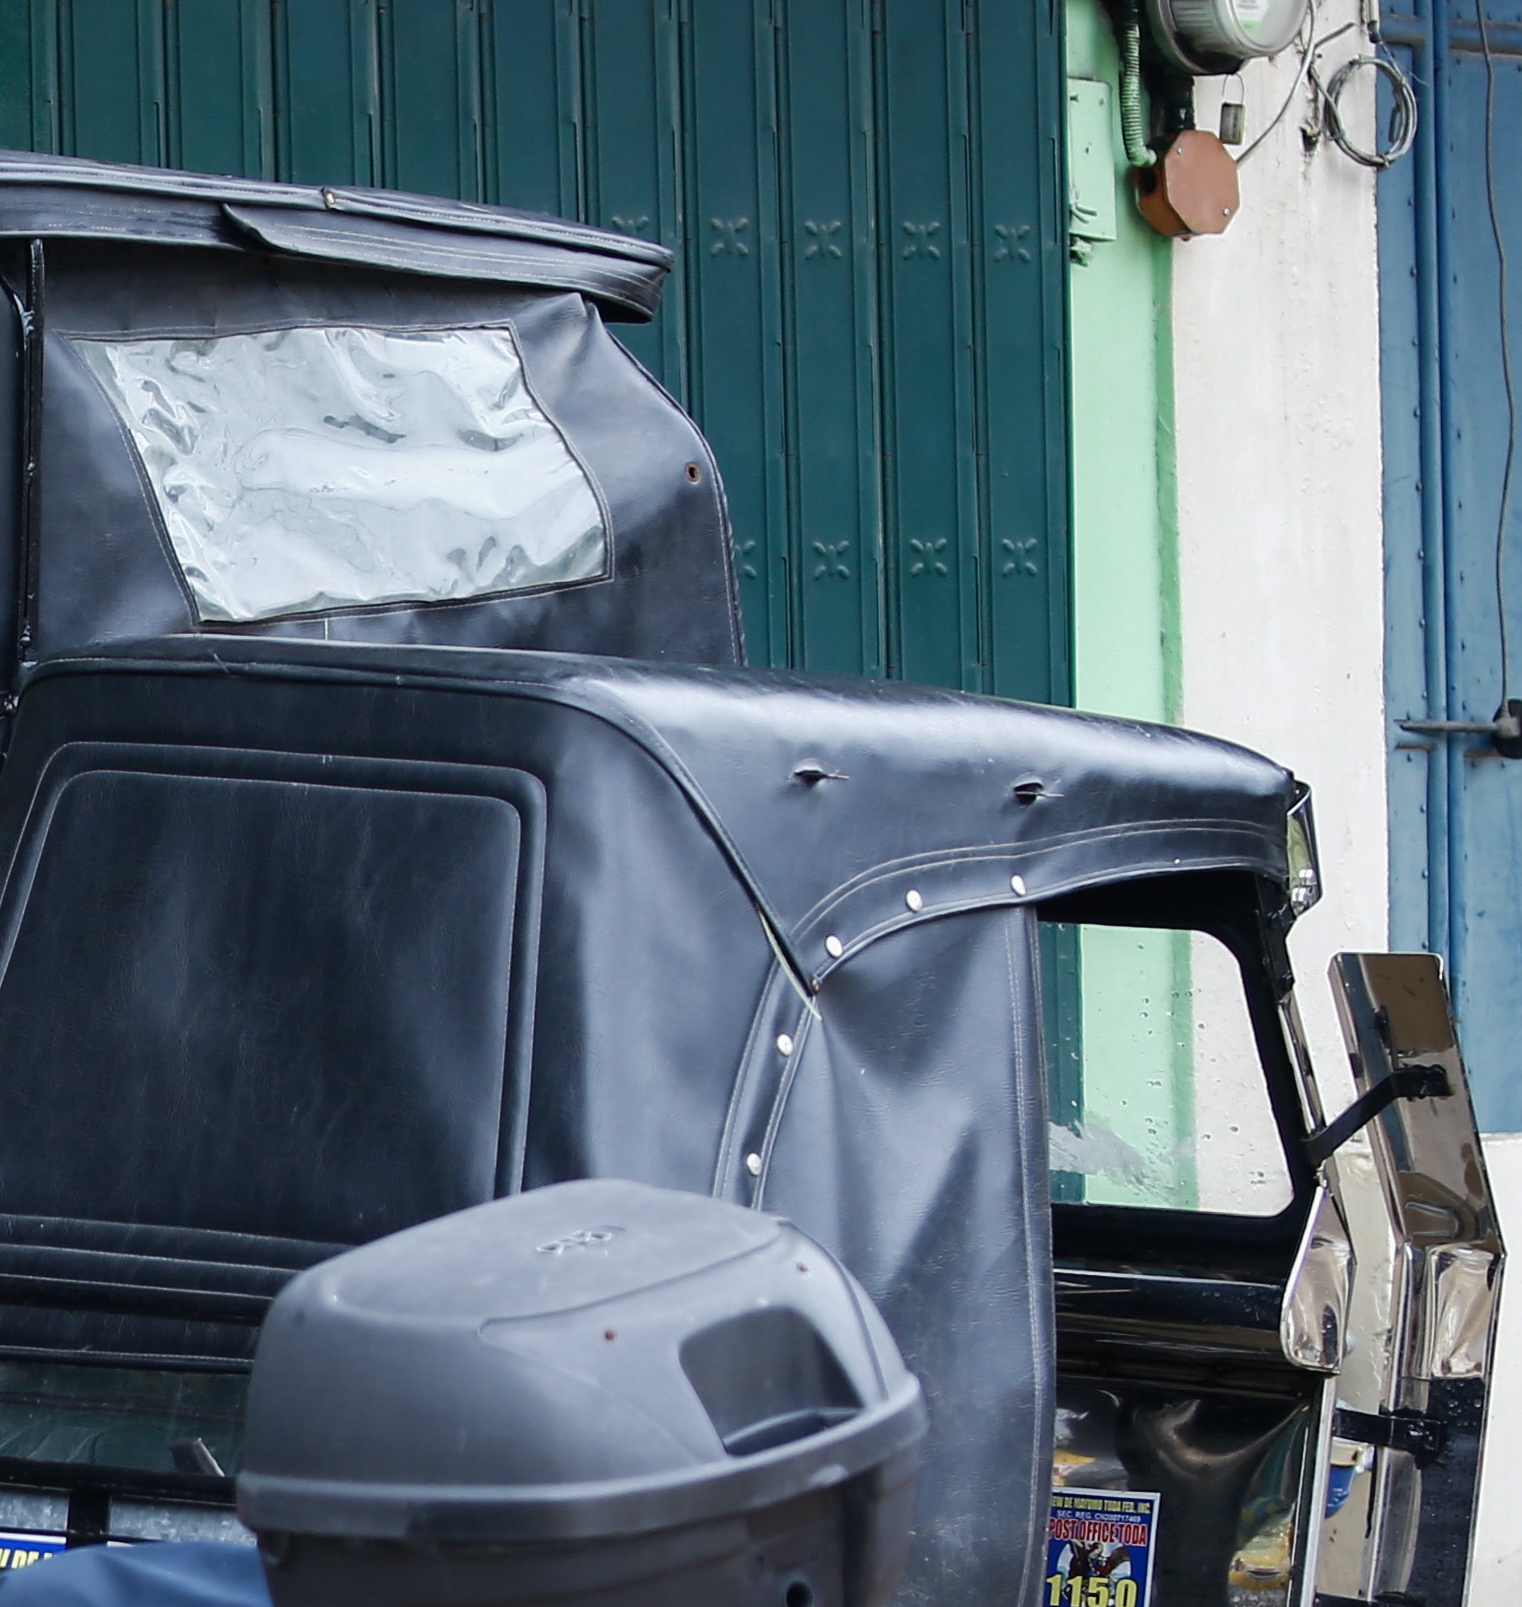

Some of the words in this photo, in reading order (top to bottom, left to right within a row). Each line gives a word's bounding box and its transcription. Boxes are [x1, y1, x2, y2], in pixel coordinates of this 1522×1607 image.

[1049, 1518, 1078, 1541] POST
[1079, 1519, 1116, 1543] OFFICE
[1117, 1522, 1148, 1546] TODA
